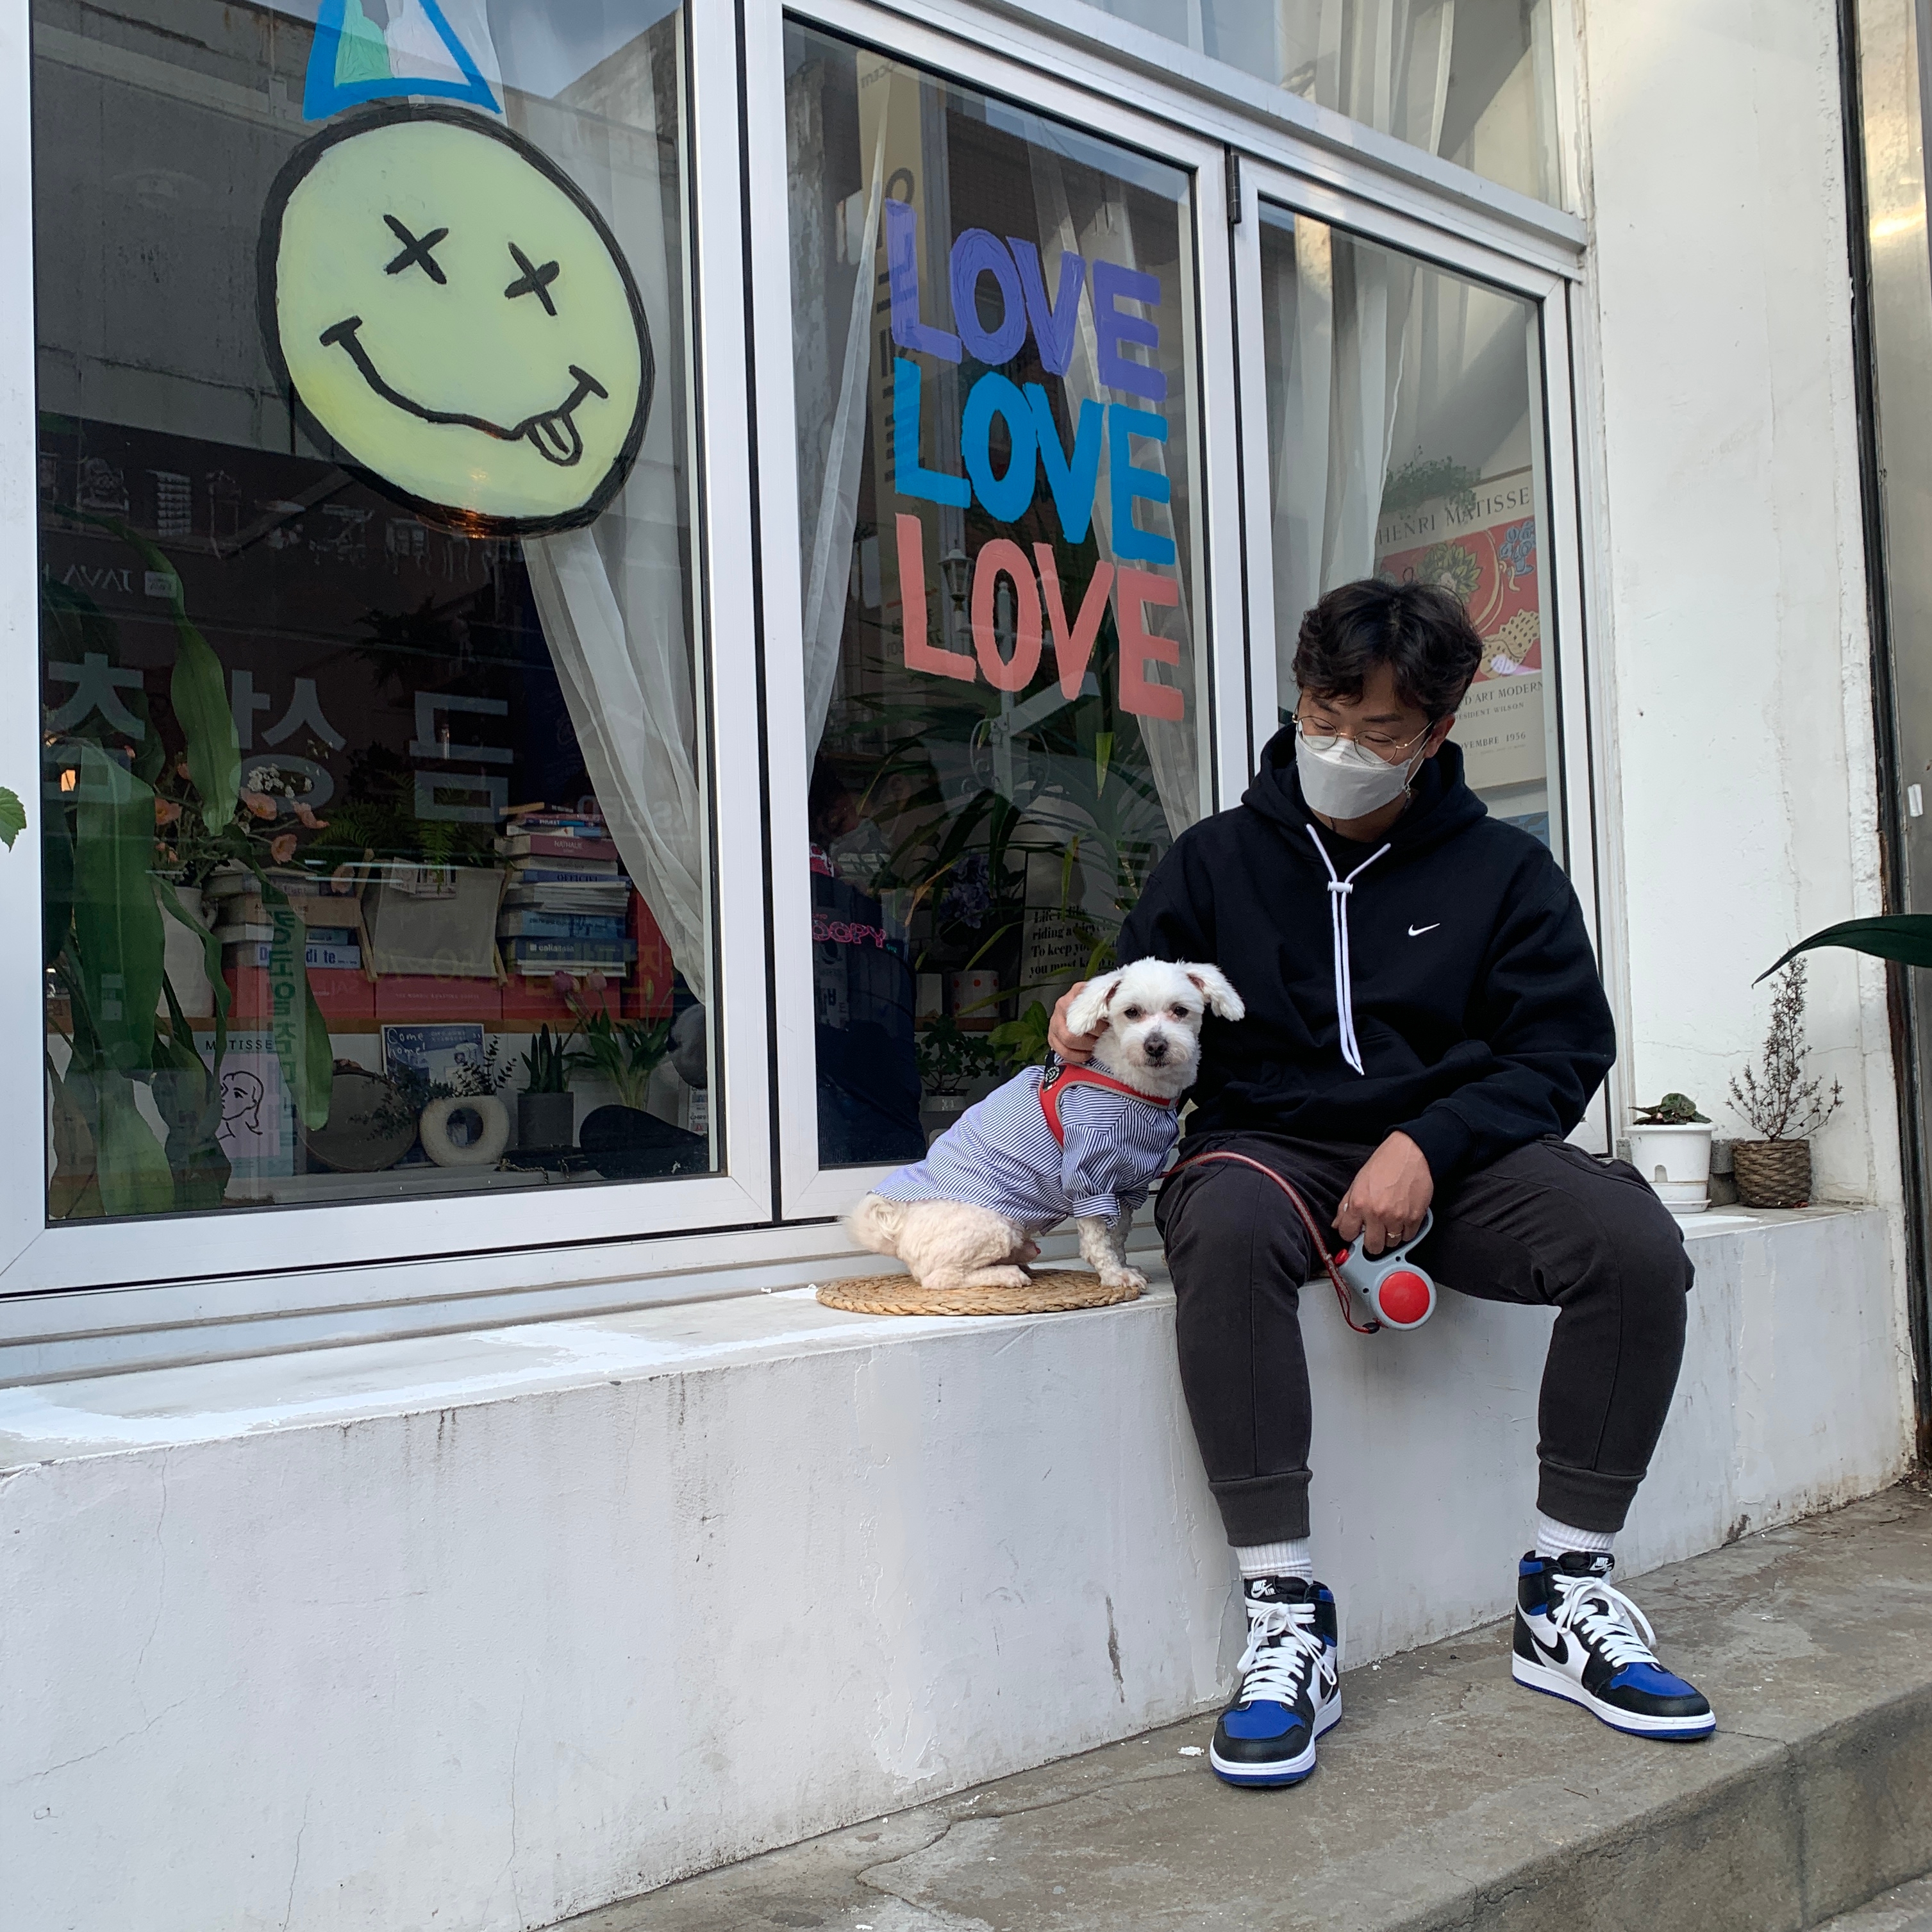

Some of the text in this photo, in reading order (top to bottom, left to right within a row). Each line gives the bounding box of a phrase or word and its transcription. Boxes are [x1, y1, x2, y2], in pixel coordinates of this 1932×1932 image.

[885, 198, 1167, 403] LOVE
[894, 356, 1176, 566] LOVE
[1379, 487, 1530, 545] HENRI MATISSE
[895, 513, 1185, 721] LOVE
[1494, 702, 1525, 713] WILSON
[1033, 909, 1053, 924] Life
[1033, 926, 1064, 941] riding
[1065, 928, 1072, 937] a
[1031, 945, 1045, 957] To
[1047, 944, 1072, 957] keep
[1029, 965, 1048, 979] you
[387, 1028, 424, 1044] Come
[205, 1039, 273, 1051] MTISSE
[386, 1042, 427, 1062] home!
[1595, 1557, 1610, 1567] NIKE
[1253, 1579, 1267, 1592] NIKE
[1265, 1587, 1276, 1597] AIR
